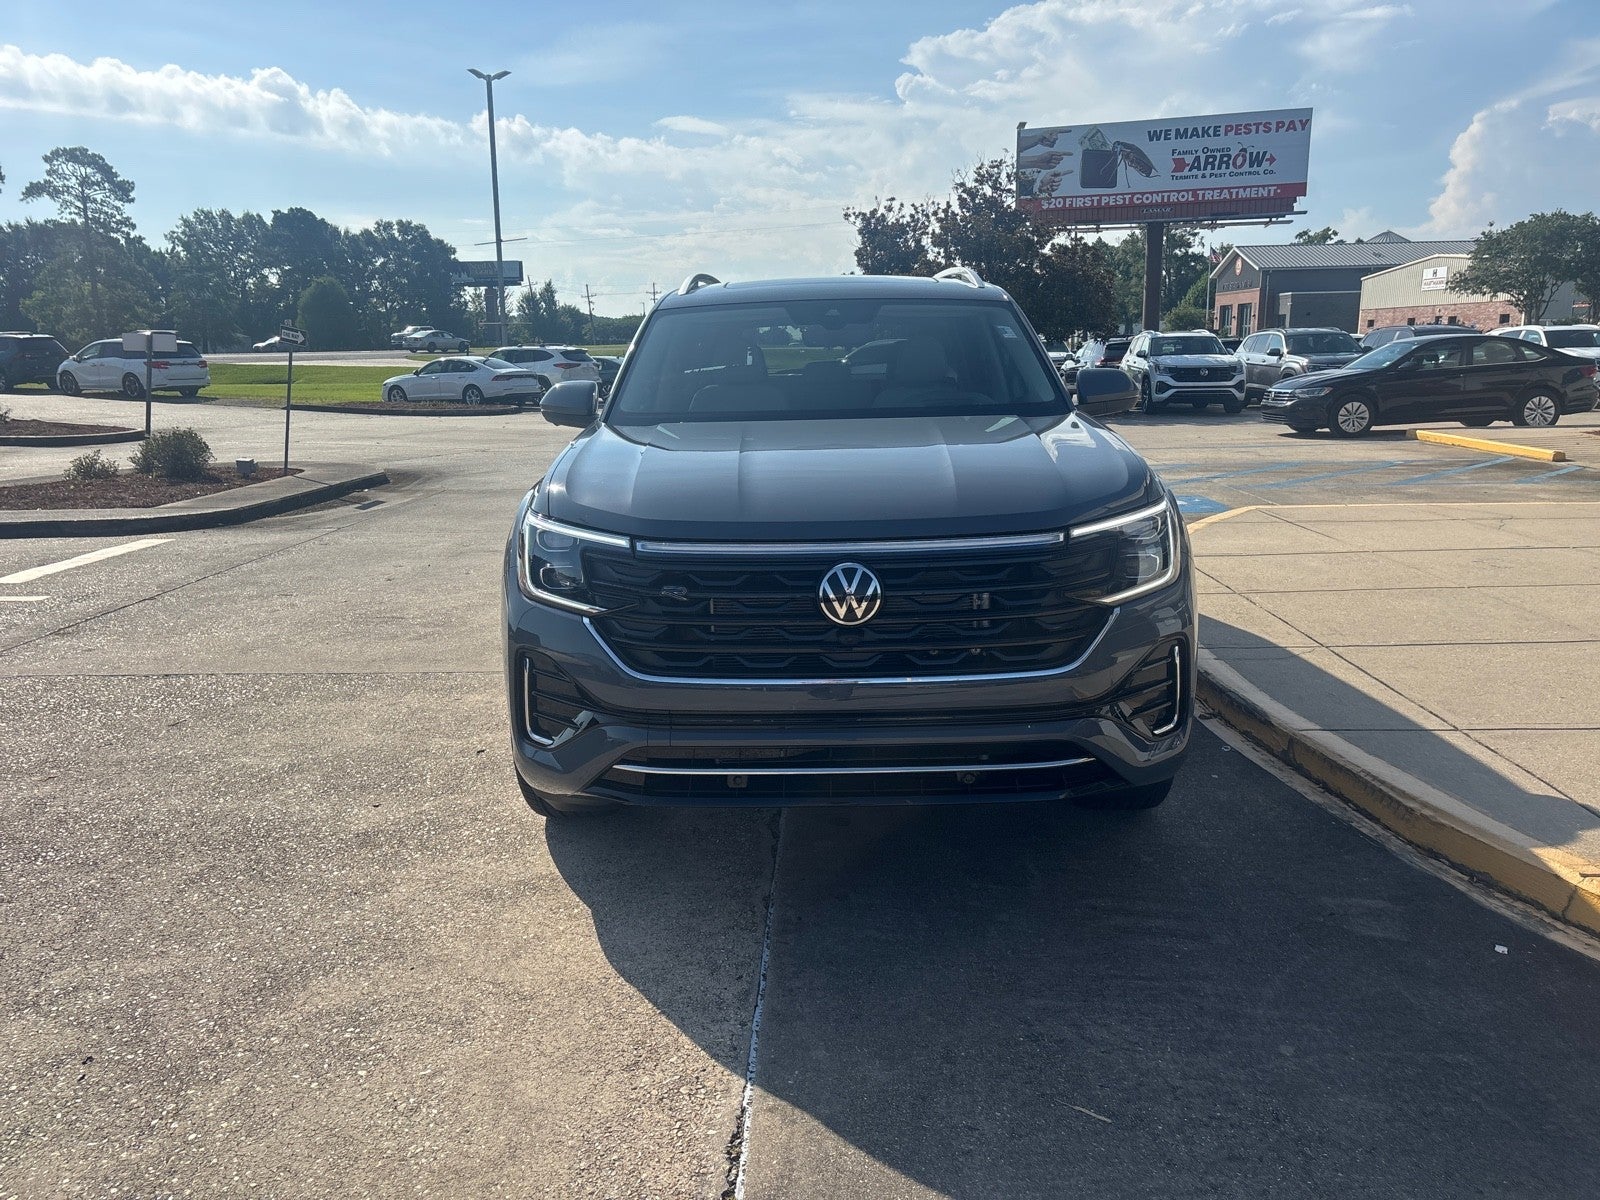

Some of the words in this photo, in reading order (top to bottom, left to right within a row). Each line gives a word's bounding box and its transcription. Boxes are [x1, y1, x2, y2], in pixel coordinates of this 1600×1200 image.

[1147, 129, 1172, 142] WE
[1174, 125, 1222, 141] MAKE
[1224, 121, 1273, 137] PESTS
[1275, 118, 1310, 133] PAY
[1171, 148, 1199, 156] FAMILY
[1201, 146, 1232, 155] OWNED
[1188, 150, 1267, 172] ARROW
[1170, 173, 1199, 181] TERMITE
[1209, 171, 1227, 179] PEST
[1228, 170, 1261, 178] CONTROL
[1041, 197, 1064, 209] $20
[1065, 196, 1100, 208] FIRST
[1101, 194, 1132, 206] PEST
[1133, 191, 1195, 204] CONTROL
